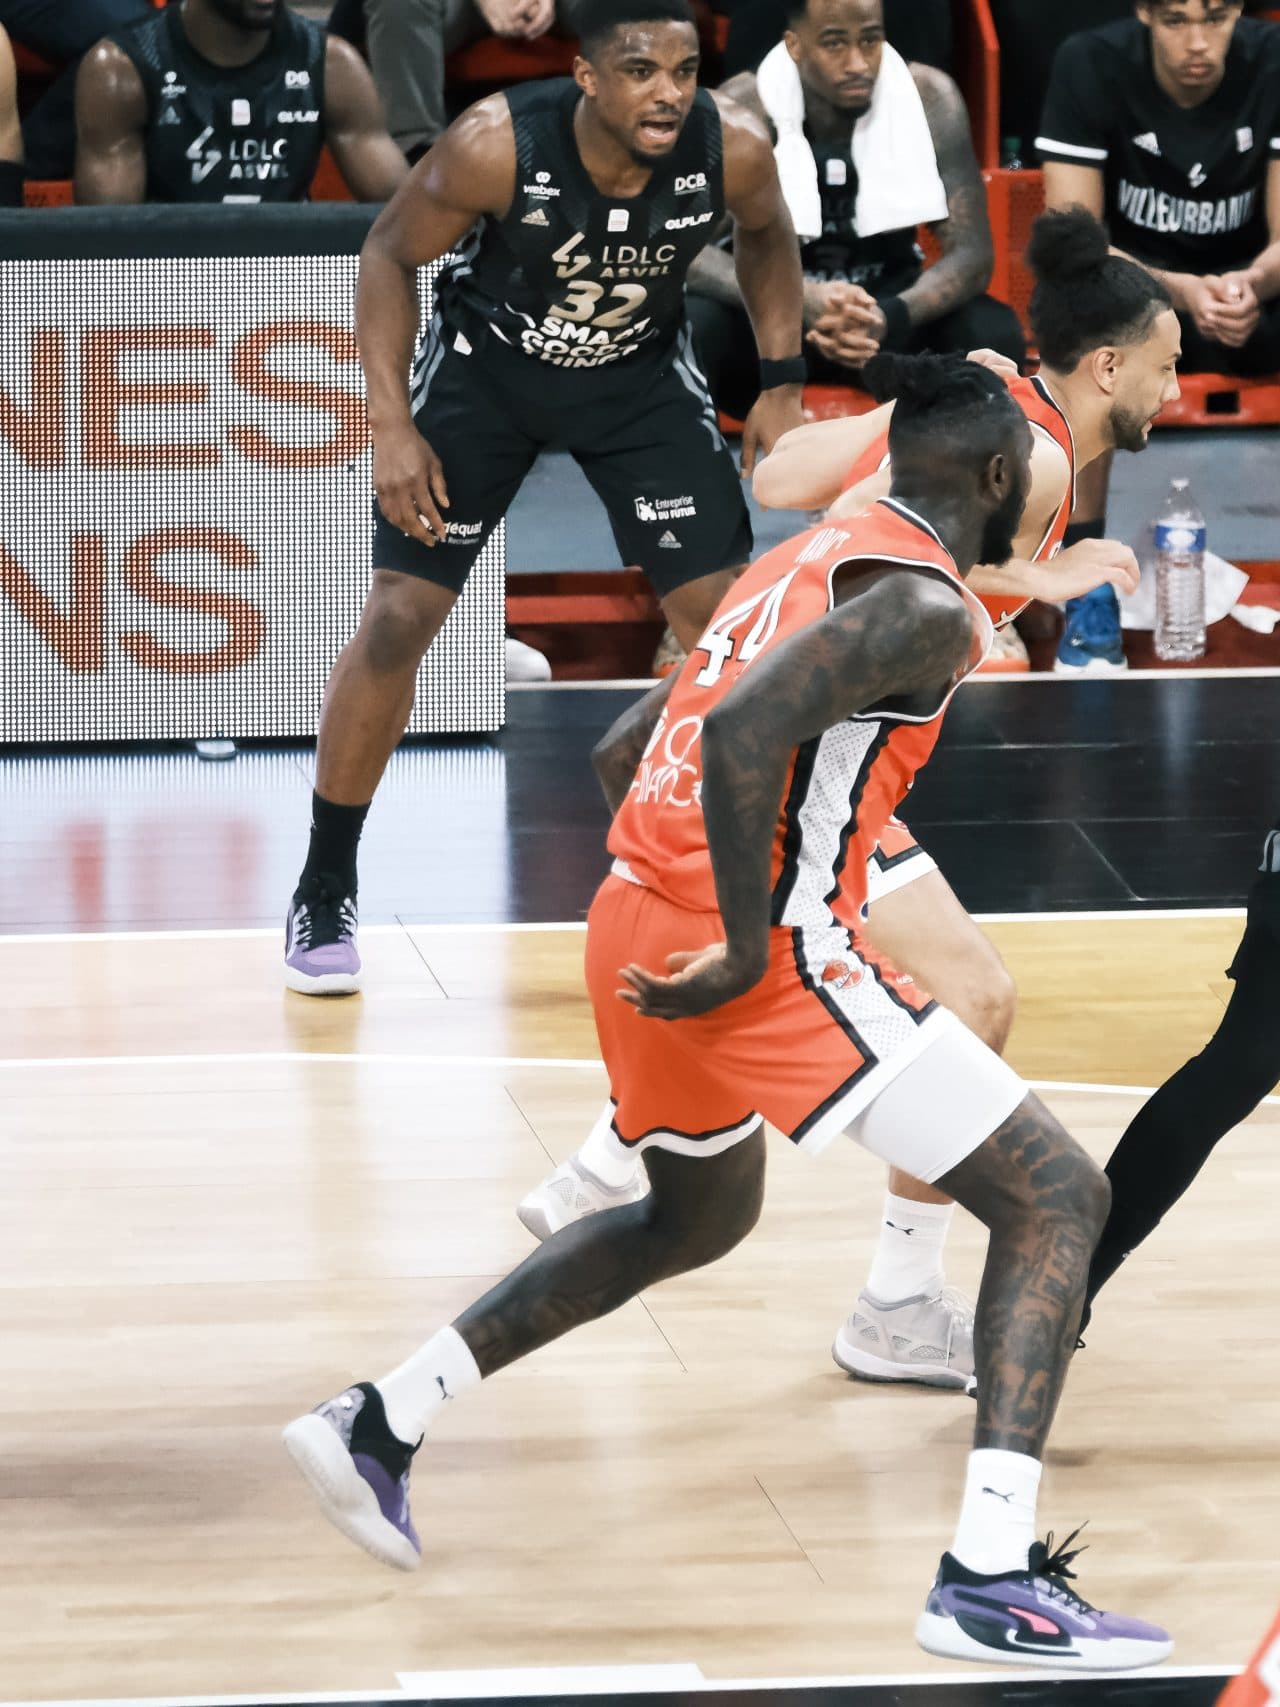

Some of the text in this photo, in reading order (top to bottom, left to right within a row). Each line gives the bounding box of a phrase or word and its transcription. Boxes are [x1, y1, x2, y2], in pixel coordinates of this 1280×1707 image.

[229, 138, 288, 160] LDLC
[674, 172, 708, 192] DCB
[602, 244, 676, 264] LDLC
[600, 265, 670, 279] ASVEL
[547, 279, 648, 328] 32
[443, 520, 483, 537] déquat
[695, 565, 800, 687] 44
